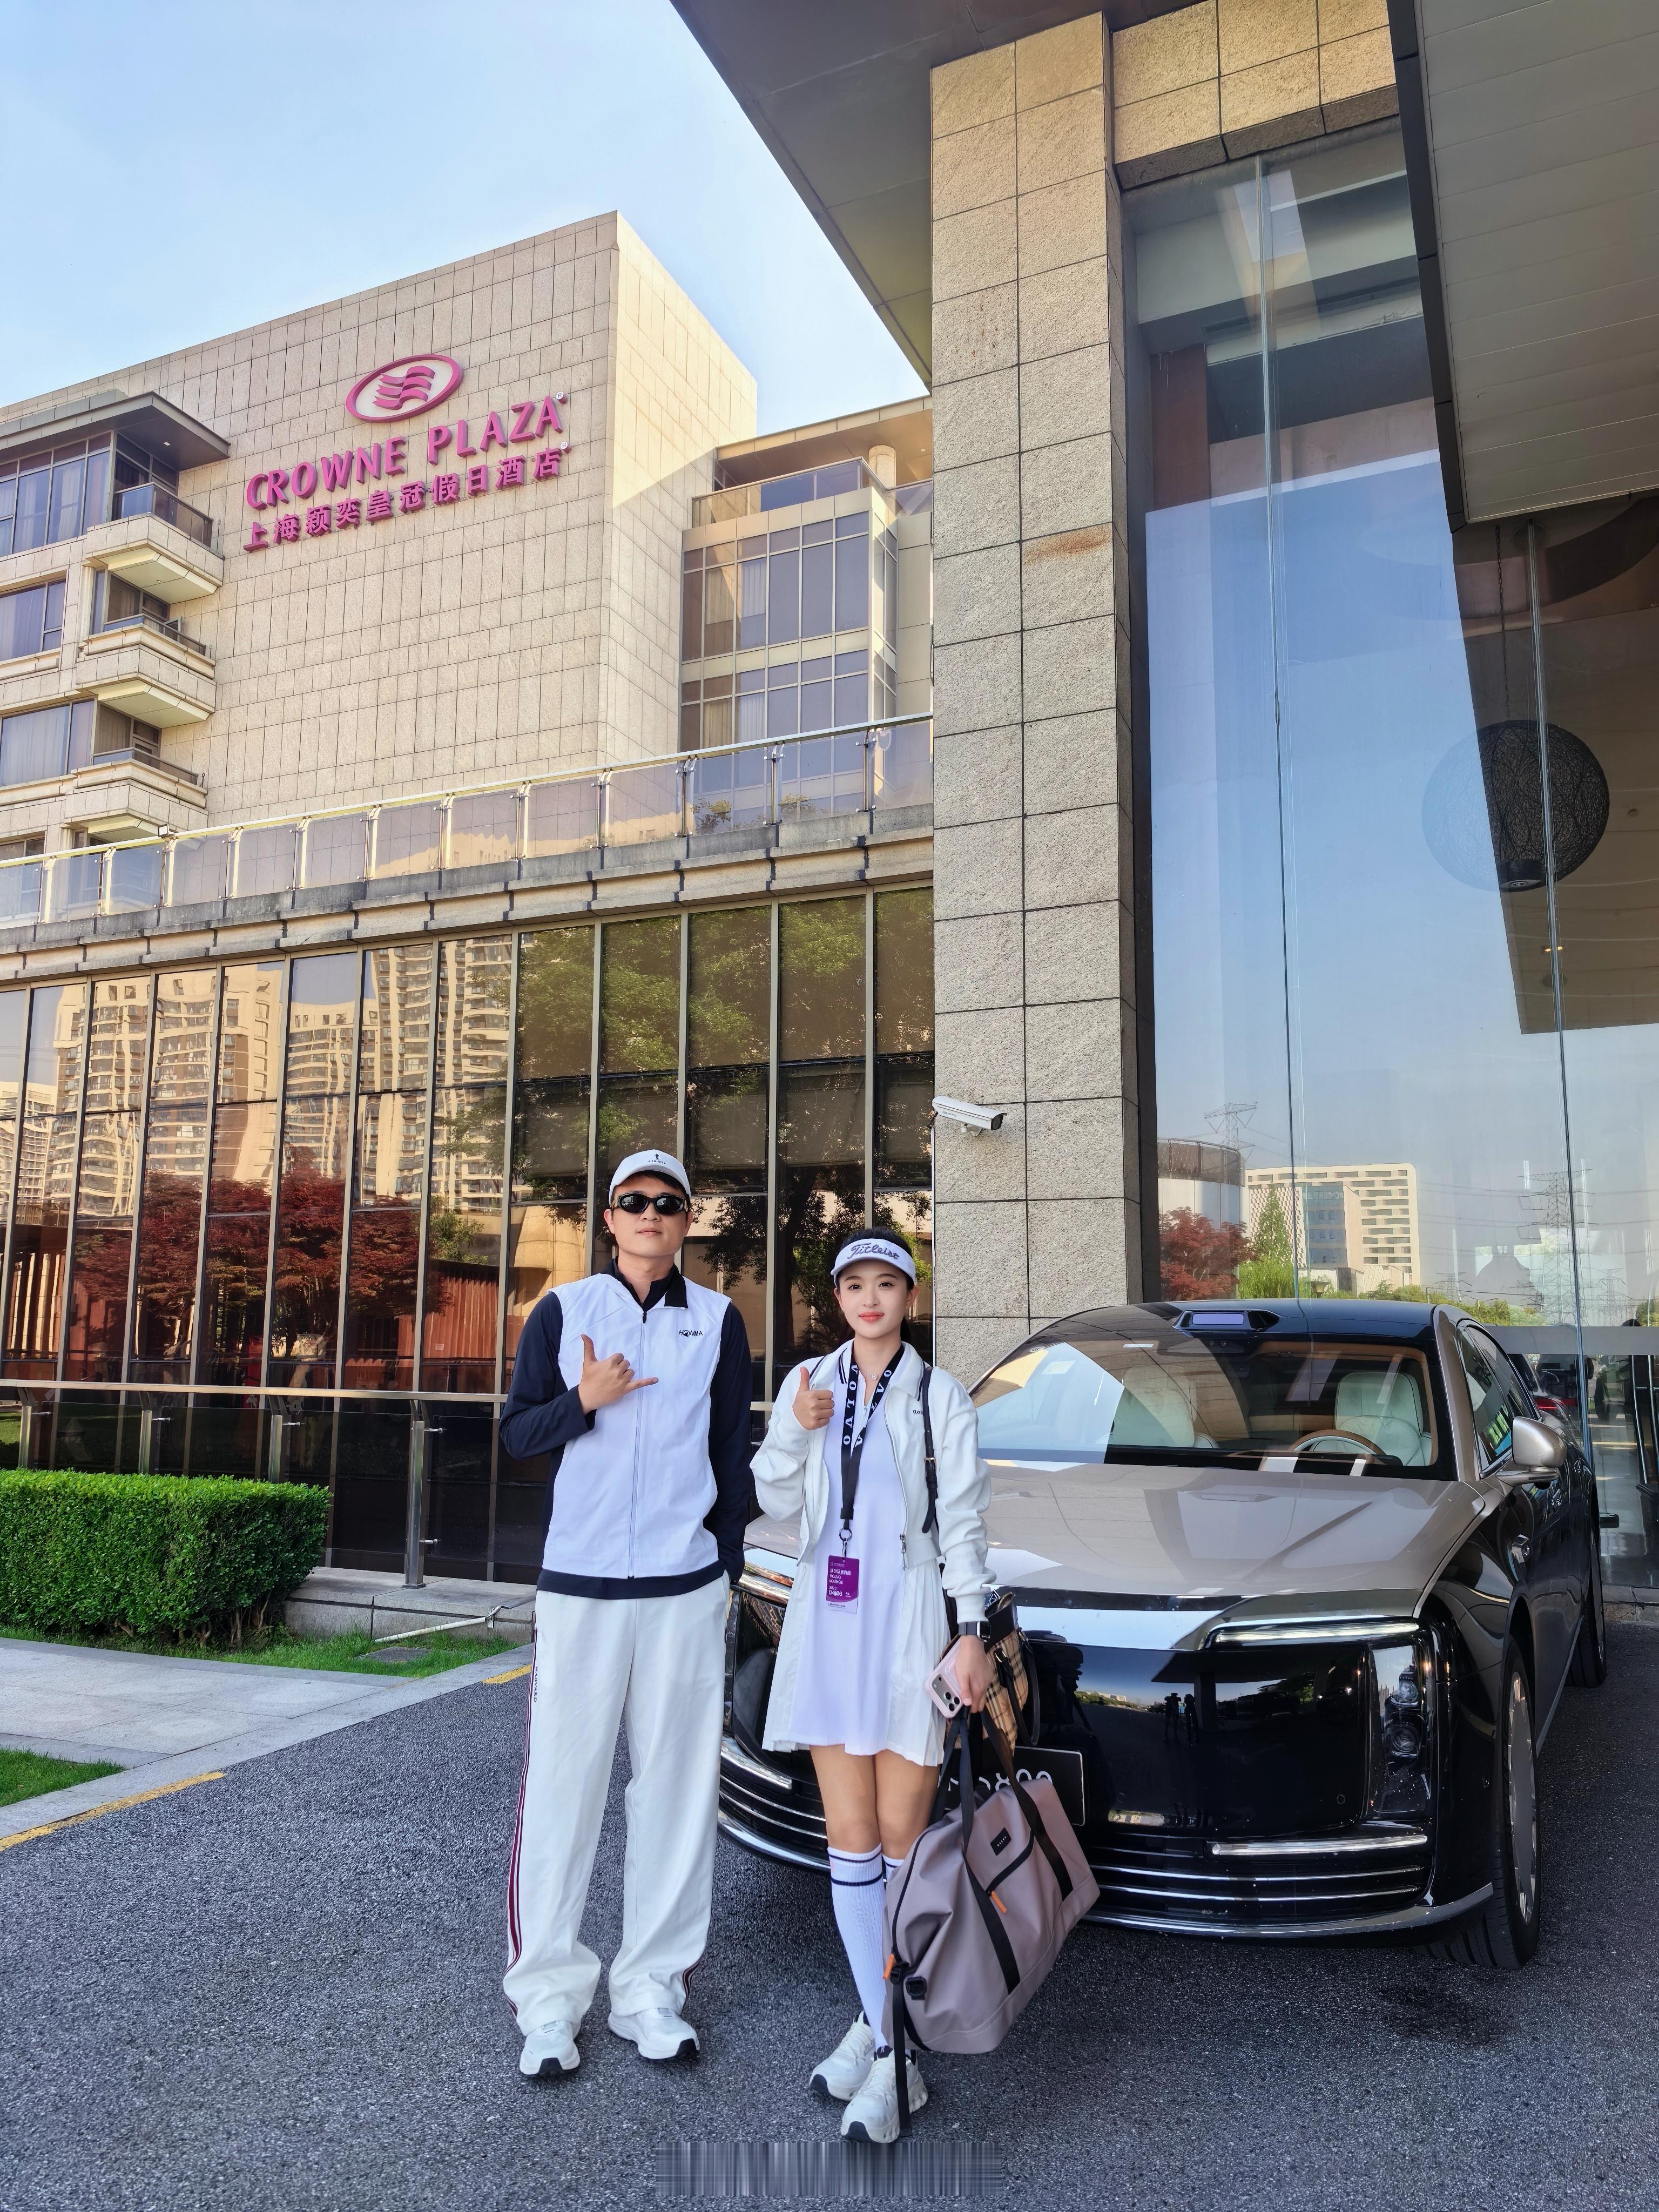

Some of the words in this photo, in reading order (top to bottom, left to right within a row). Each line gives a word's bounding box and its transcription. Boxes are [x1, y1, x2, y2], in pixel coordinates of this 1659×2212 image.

[242, 447, 563, 552] 上海颖奕皇冠假日酒店
[246, 436, 406, 510] CROWNE
[428, 395, 563, 465] PLAZA
[847, 1243, 900, 1260] Titleist
